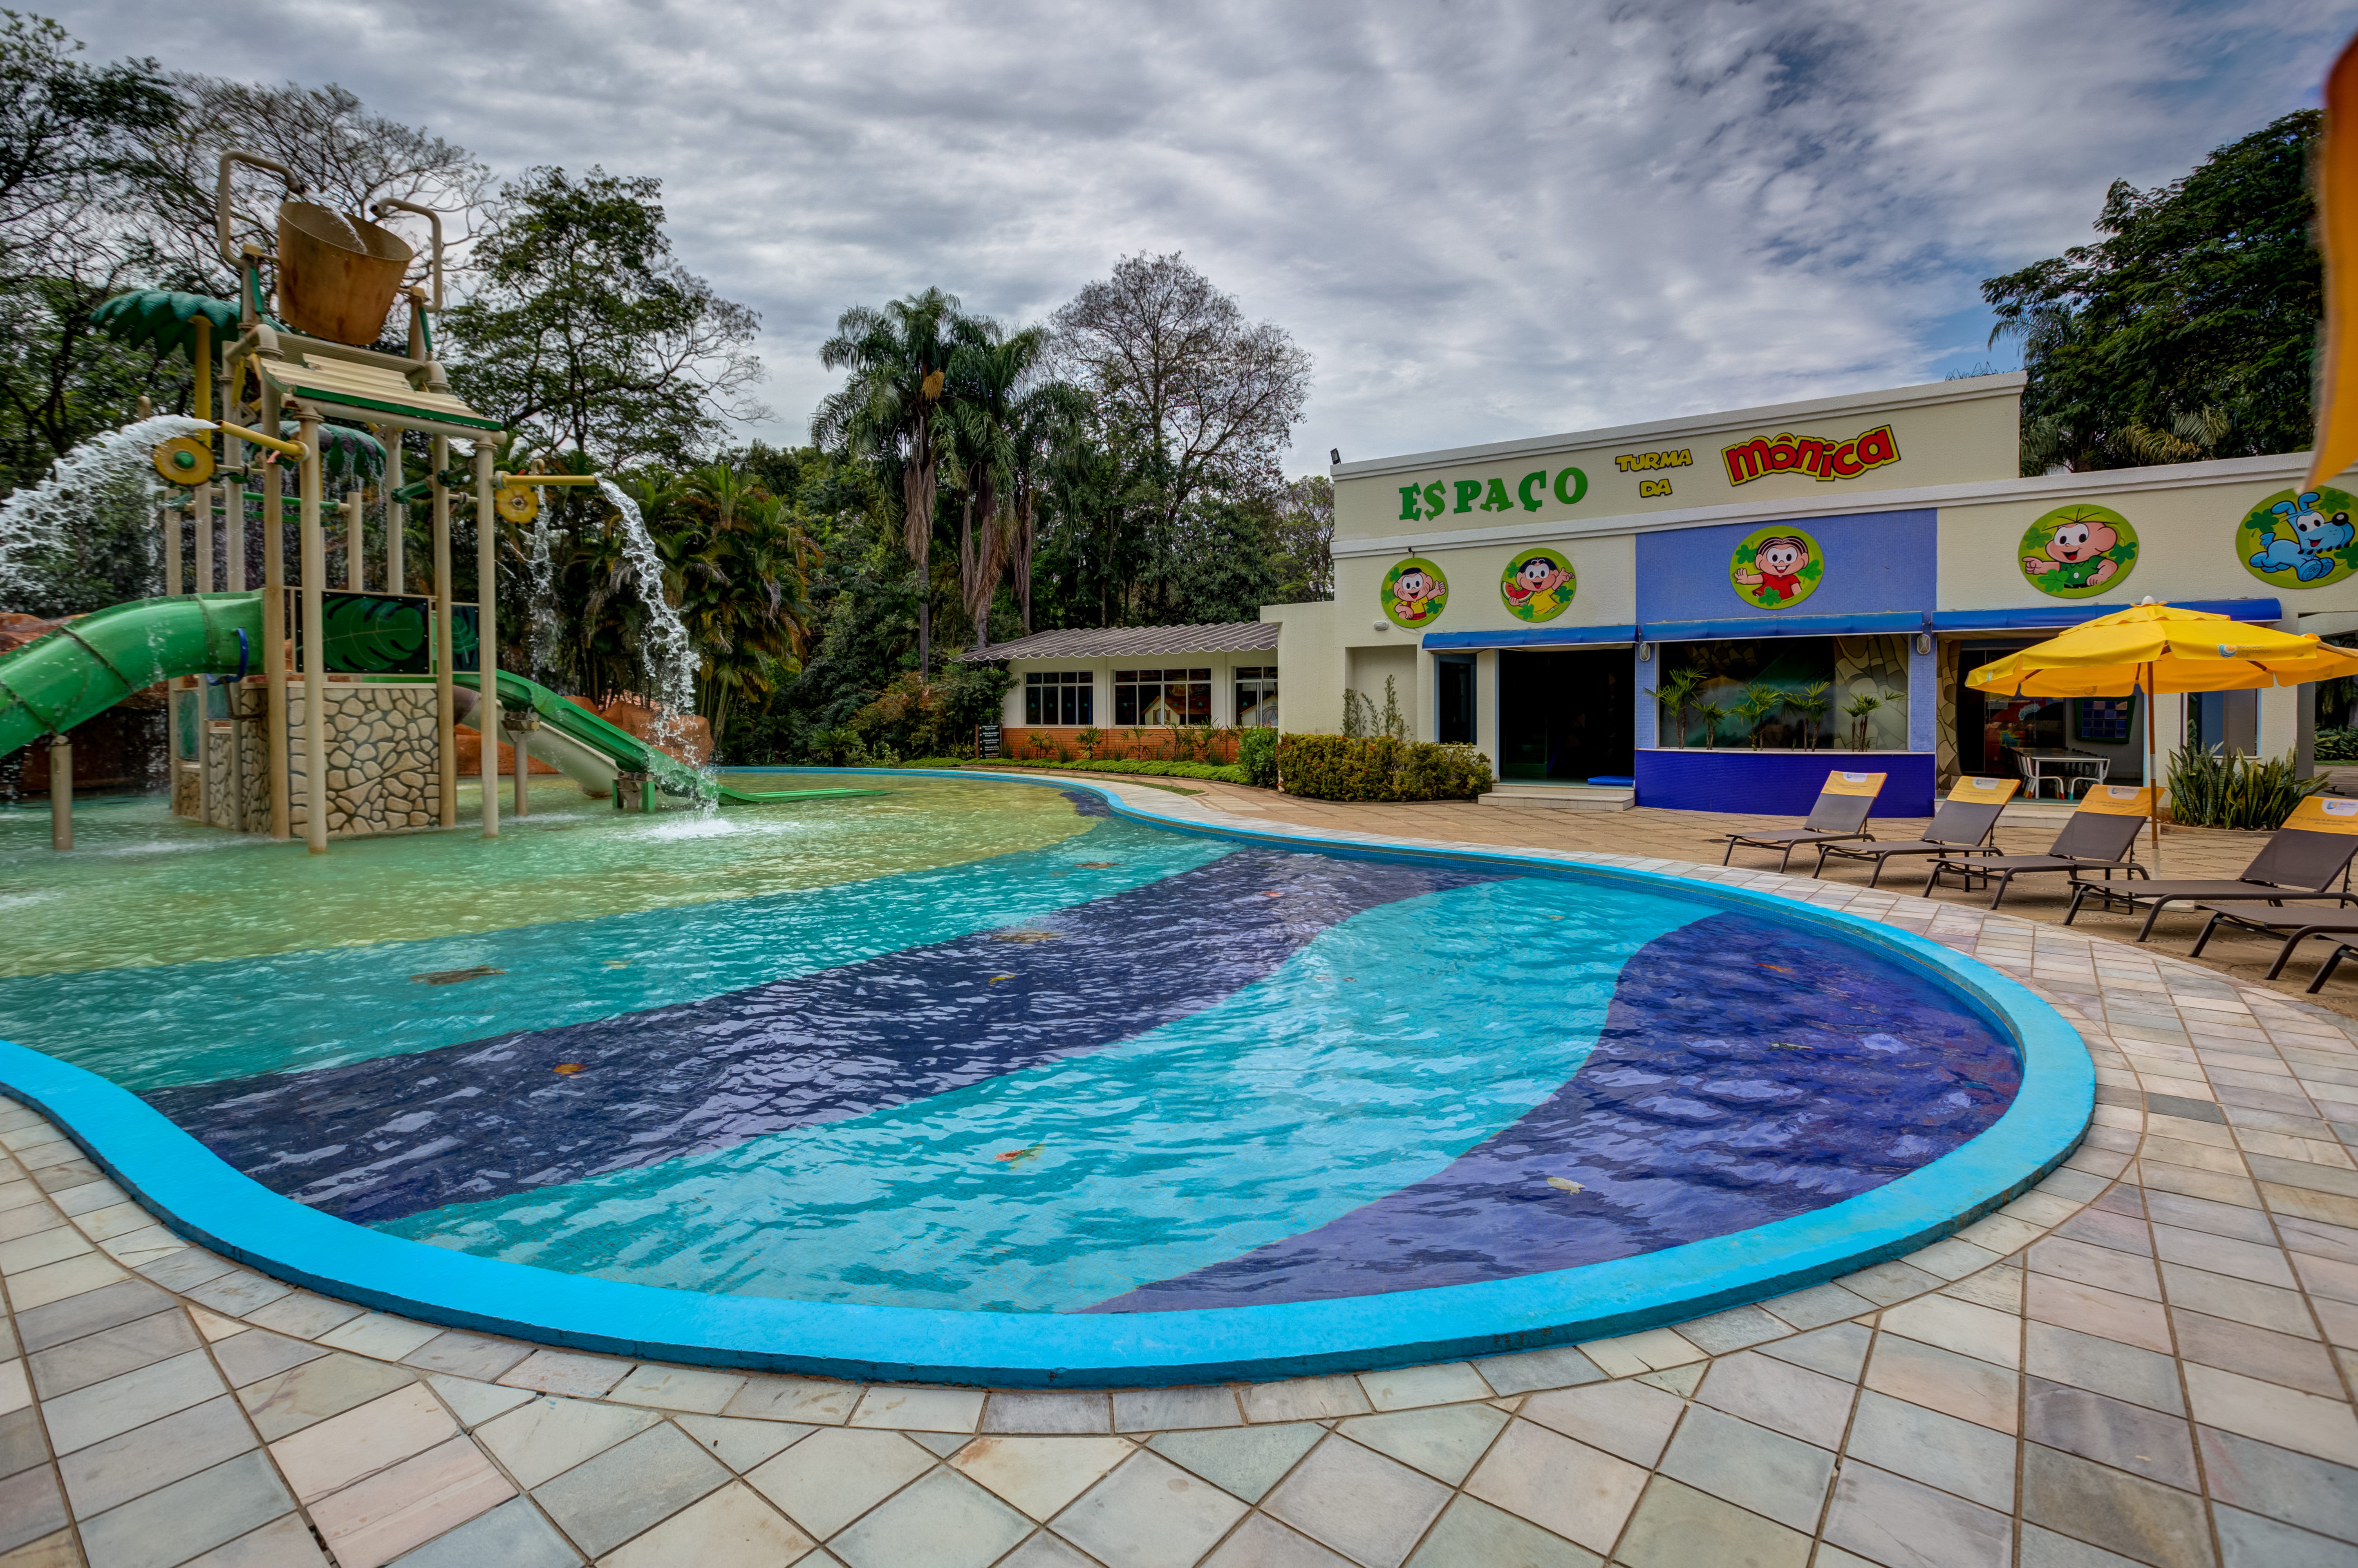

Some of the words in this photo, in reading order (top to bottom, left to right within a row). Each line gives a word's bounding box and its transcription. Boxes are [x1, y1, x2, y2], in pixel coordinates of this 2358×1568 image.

[1615, 449, 1693, 472] TURMA
[1400, 467, 1587, 520] ESPAÇO
[1639, 479, 1673, 498] DA
